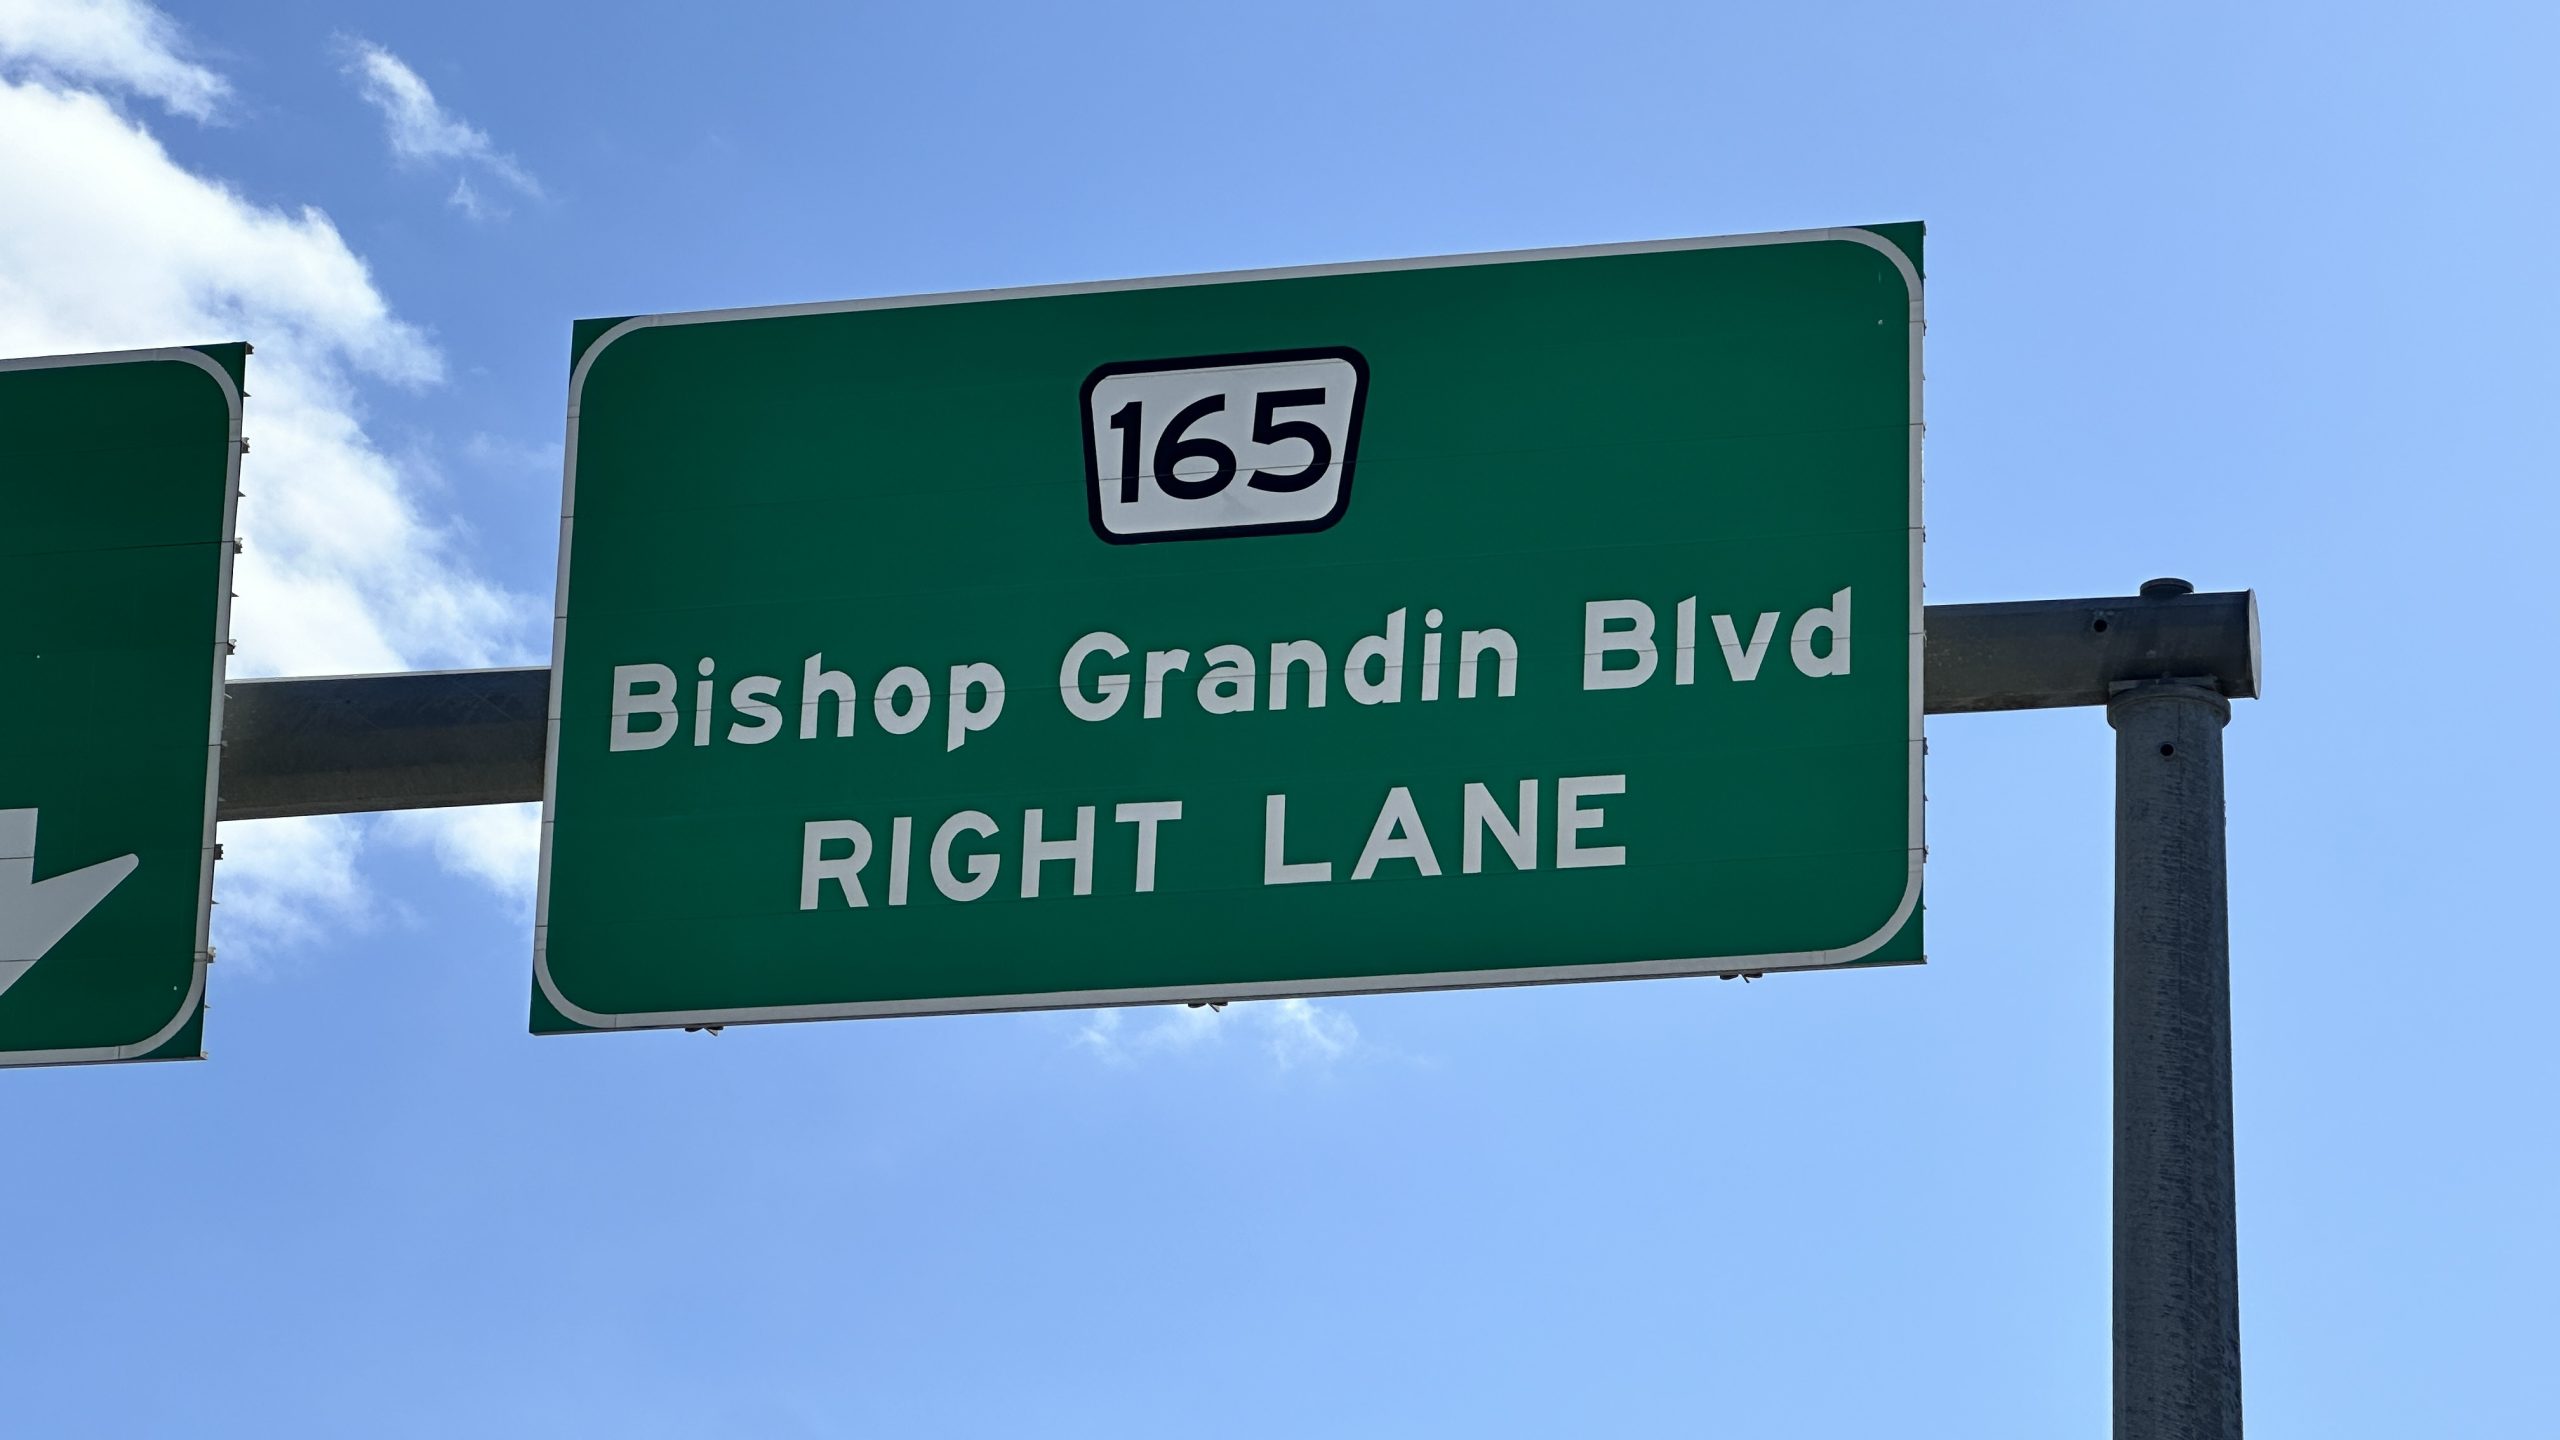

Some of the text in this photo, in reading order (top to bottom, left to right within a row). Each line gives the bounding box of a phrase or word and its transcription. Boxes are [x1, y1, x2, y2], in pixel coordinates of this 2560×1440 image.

[1109, 386, 1333, 505] 165
[608, 585, 1852, 753] Bishop Grandin Blvd
[799, 773, 1627, 910] RIGHT LANE
